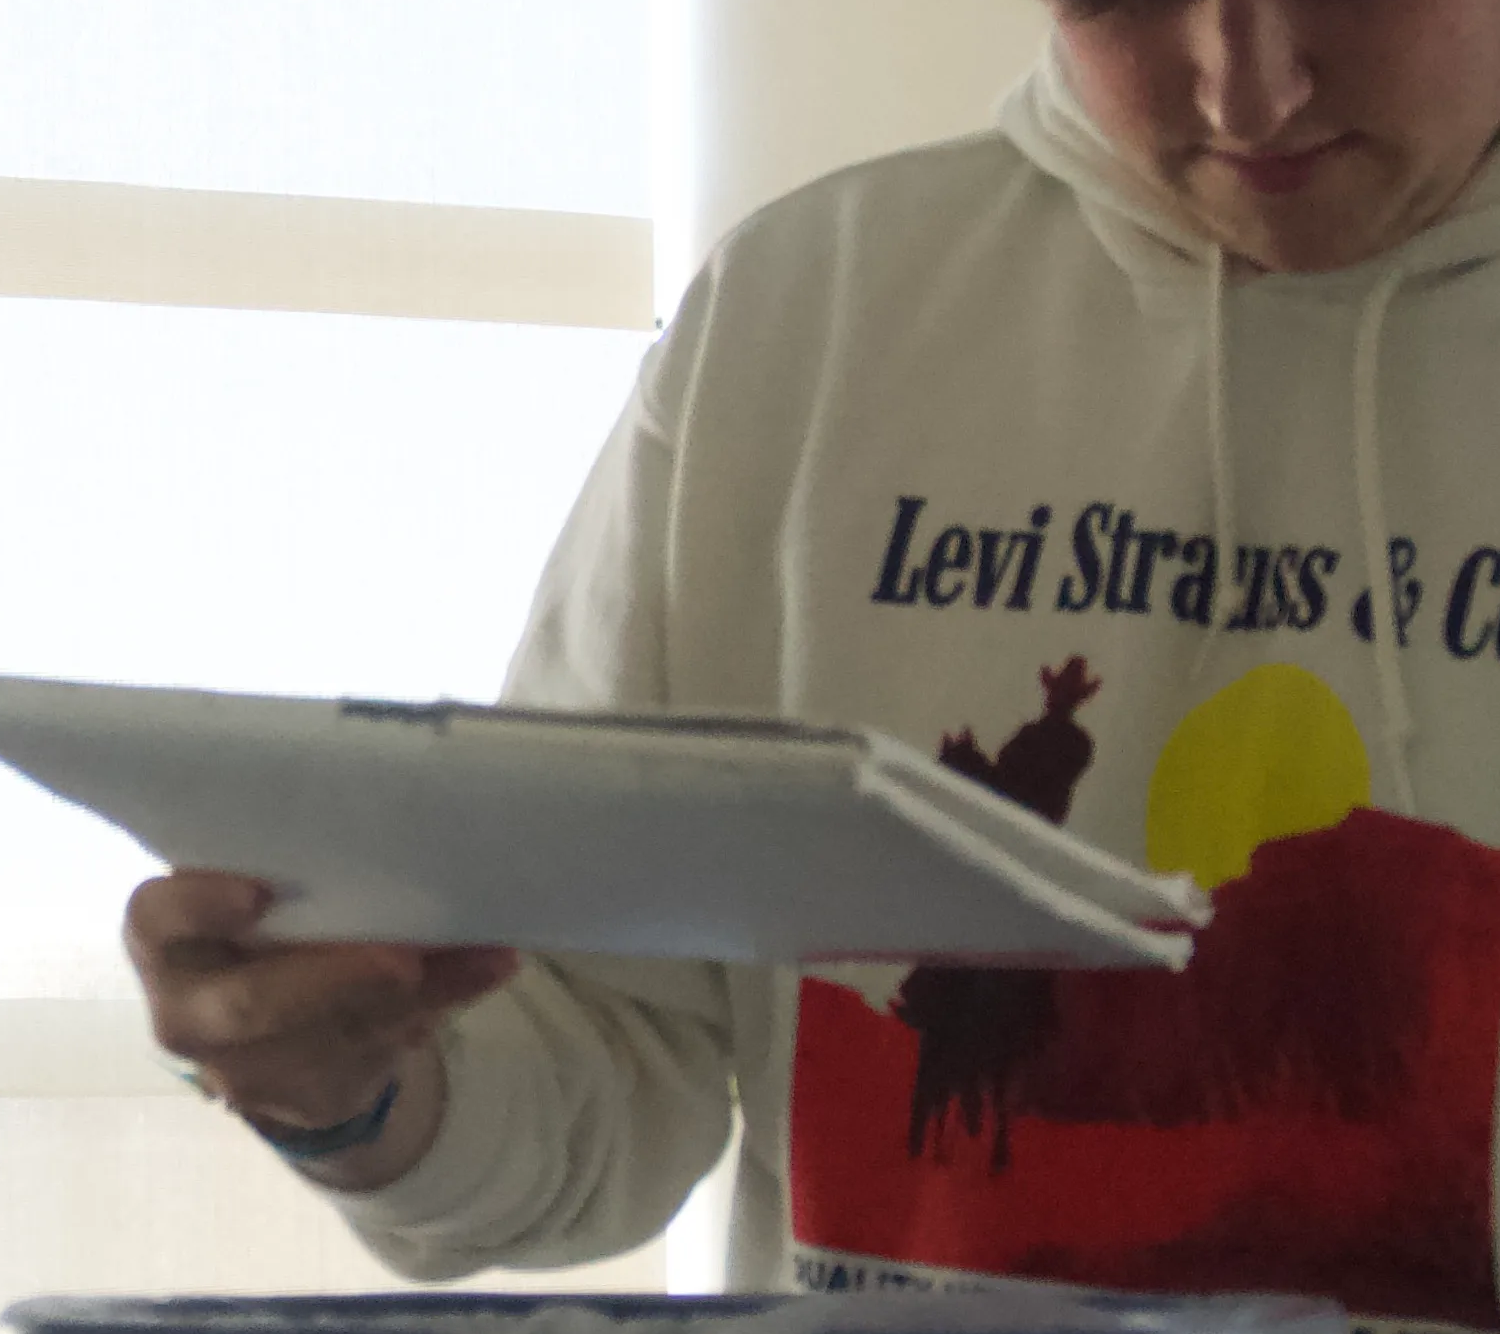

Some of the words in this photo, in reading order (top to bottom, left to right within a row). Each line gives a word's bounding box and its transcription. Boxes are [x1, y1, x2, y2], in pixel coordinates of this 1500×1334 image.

[872, 496, 1050, 609] Levi
[1056, 501, 1340, 629] Strauss
[1351, 537, 1424, 648] &
